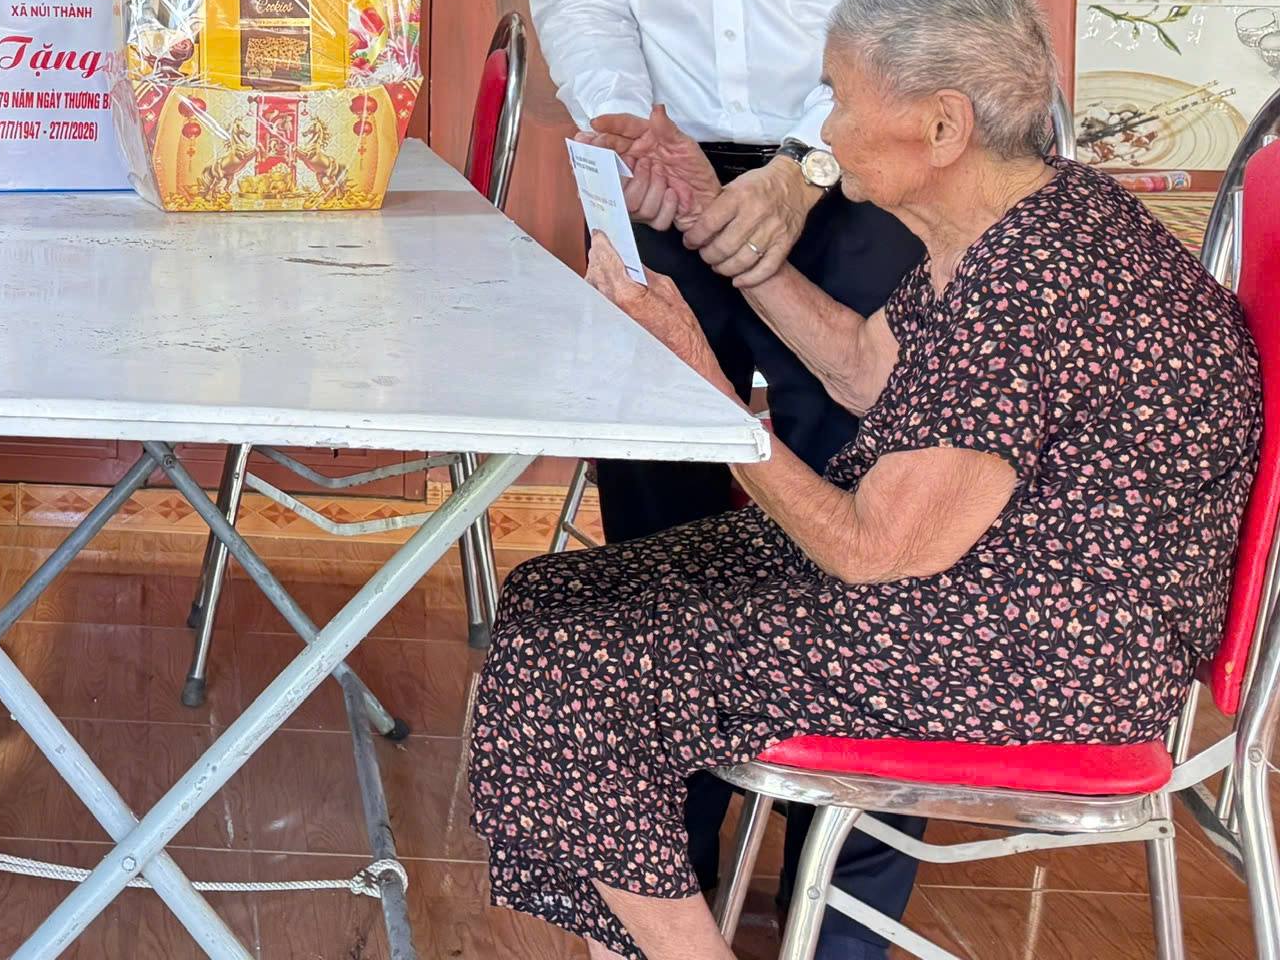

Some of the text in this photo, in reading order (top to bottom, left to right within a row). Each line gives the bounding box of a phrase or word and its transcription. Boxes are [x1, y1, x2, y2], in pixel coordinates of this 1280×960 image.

[11, 2, 93, 19] XÃ NÚI THÀNH
[12, 88, 34, 108] NĂM
[36, 88, 61, 109] NGÀY
[64, 90, 100, 110] THƯƠNG
[49, 121, 98, 141] 27/7/2026)
